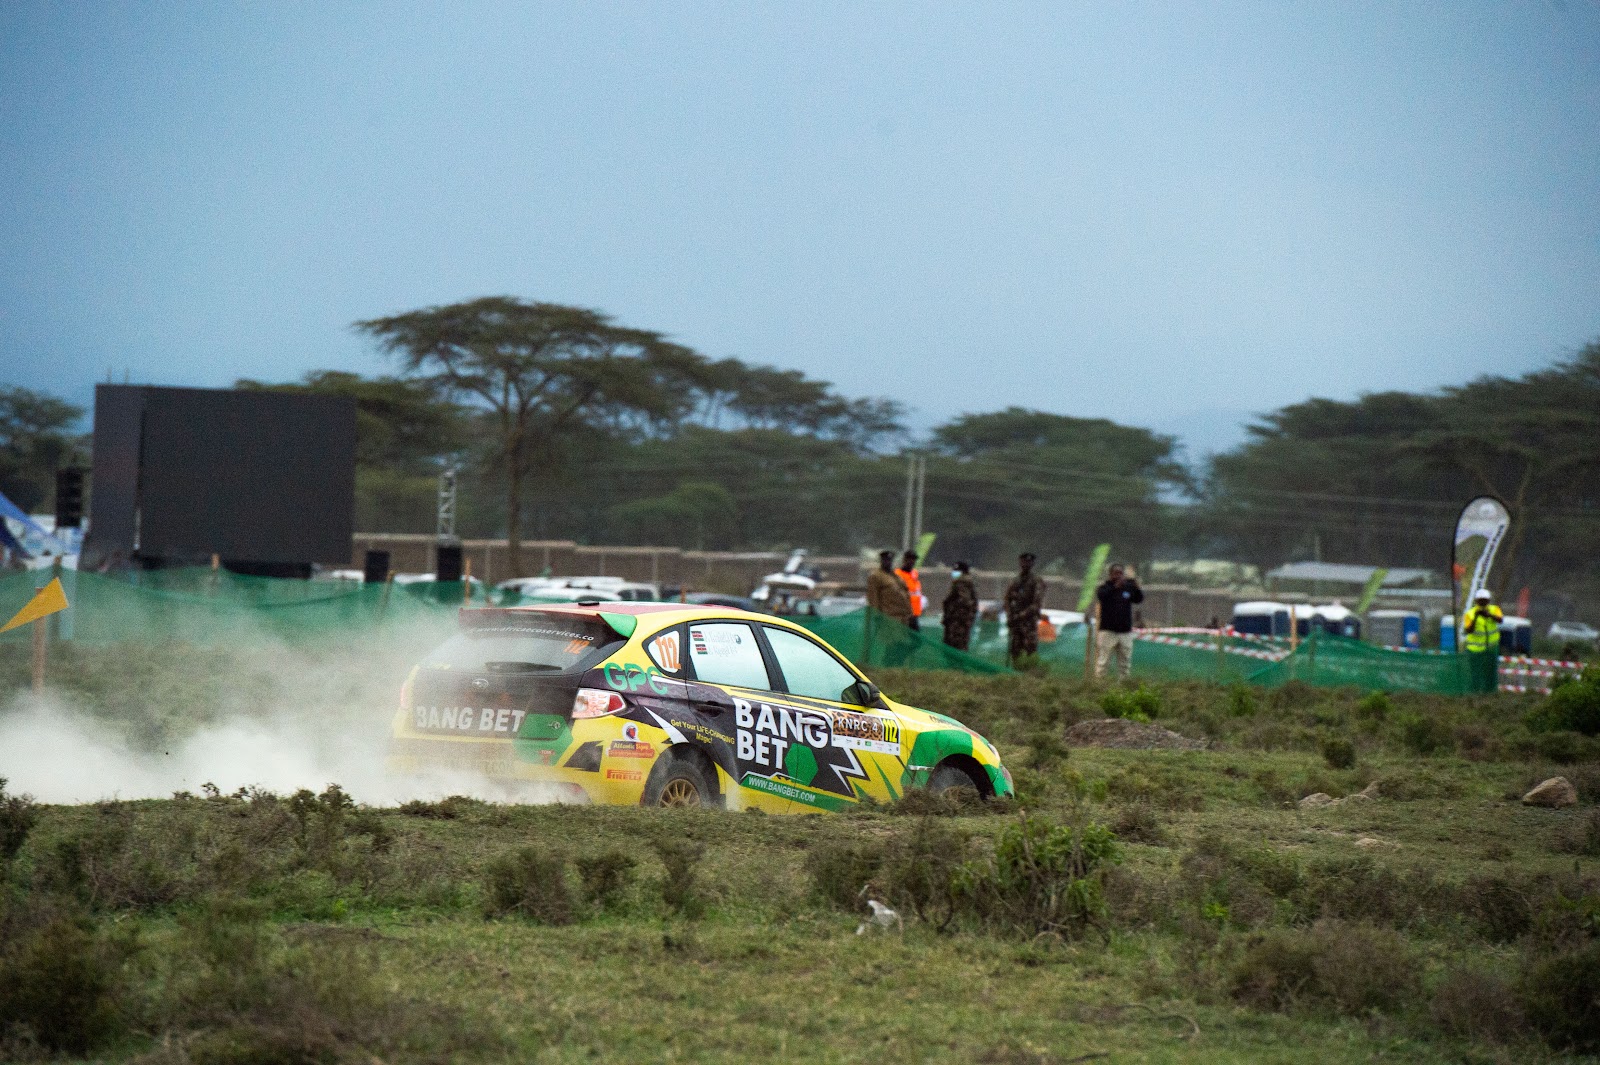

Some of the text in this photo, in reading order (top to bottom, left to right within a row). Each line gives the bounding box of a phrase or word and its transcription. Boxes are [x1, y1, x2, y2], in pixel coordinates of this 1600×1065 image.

[564, 639, 591, 655] 112
[654, 635, 682, 669] 112
[603, 662, 668, 695] GPC
[415, 705, 526, 733] BANG BET
[670, 719, 683, 728] Get
[682, 721, 696, 731] Your
[732, 697, 829, 749] BANG
[837, 717, 879, 733] KNRC 4
[882, 718, 898, 743] 112
[737, 728, 788, 770] BET
[606, 769, 642, 781] PIRELLI
[749, 777, 816, 803] WWW.BANGBET.COM
